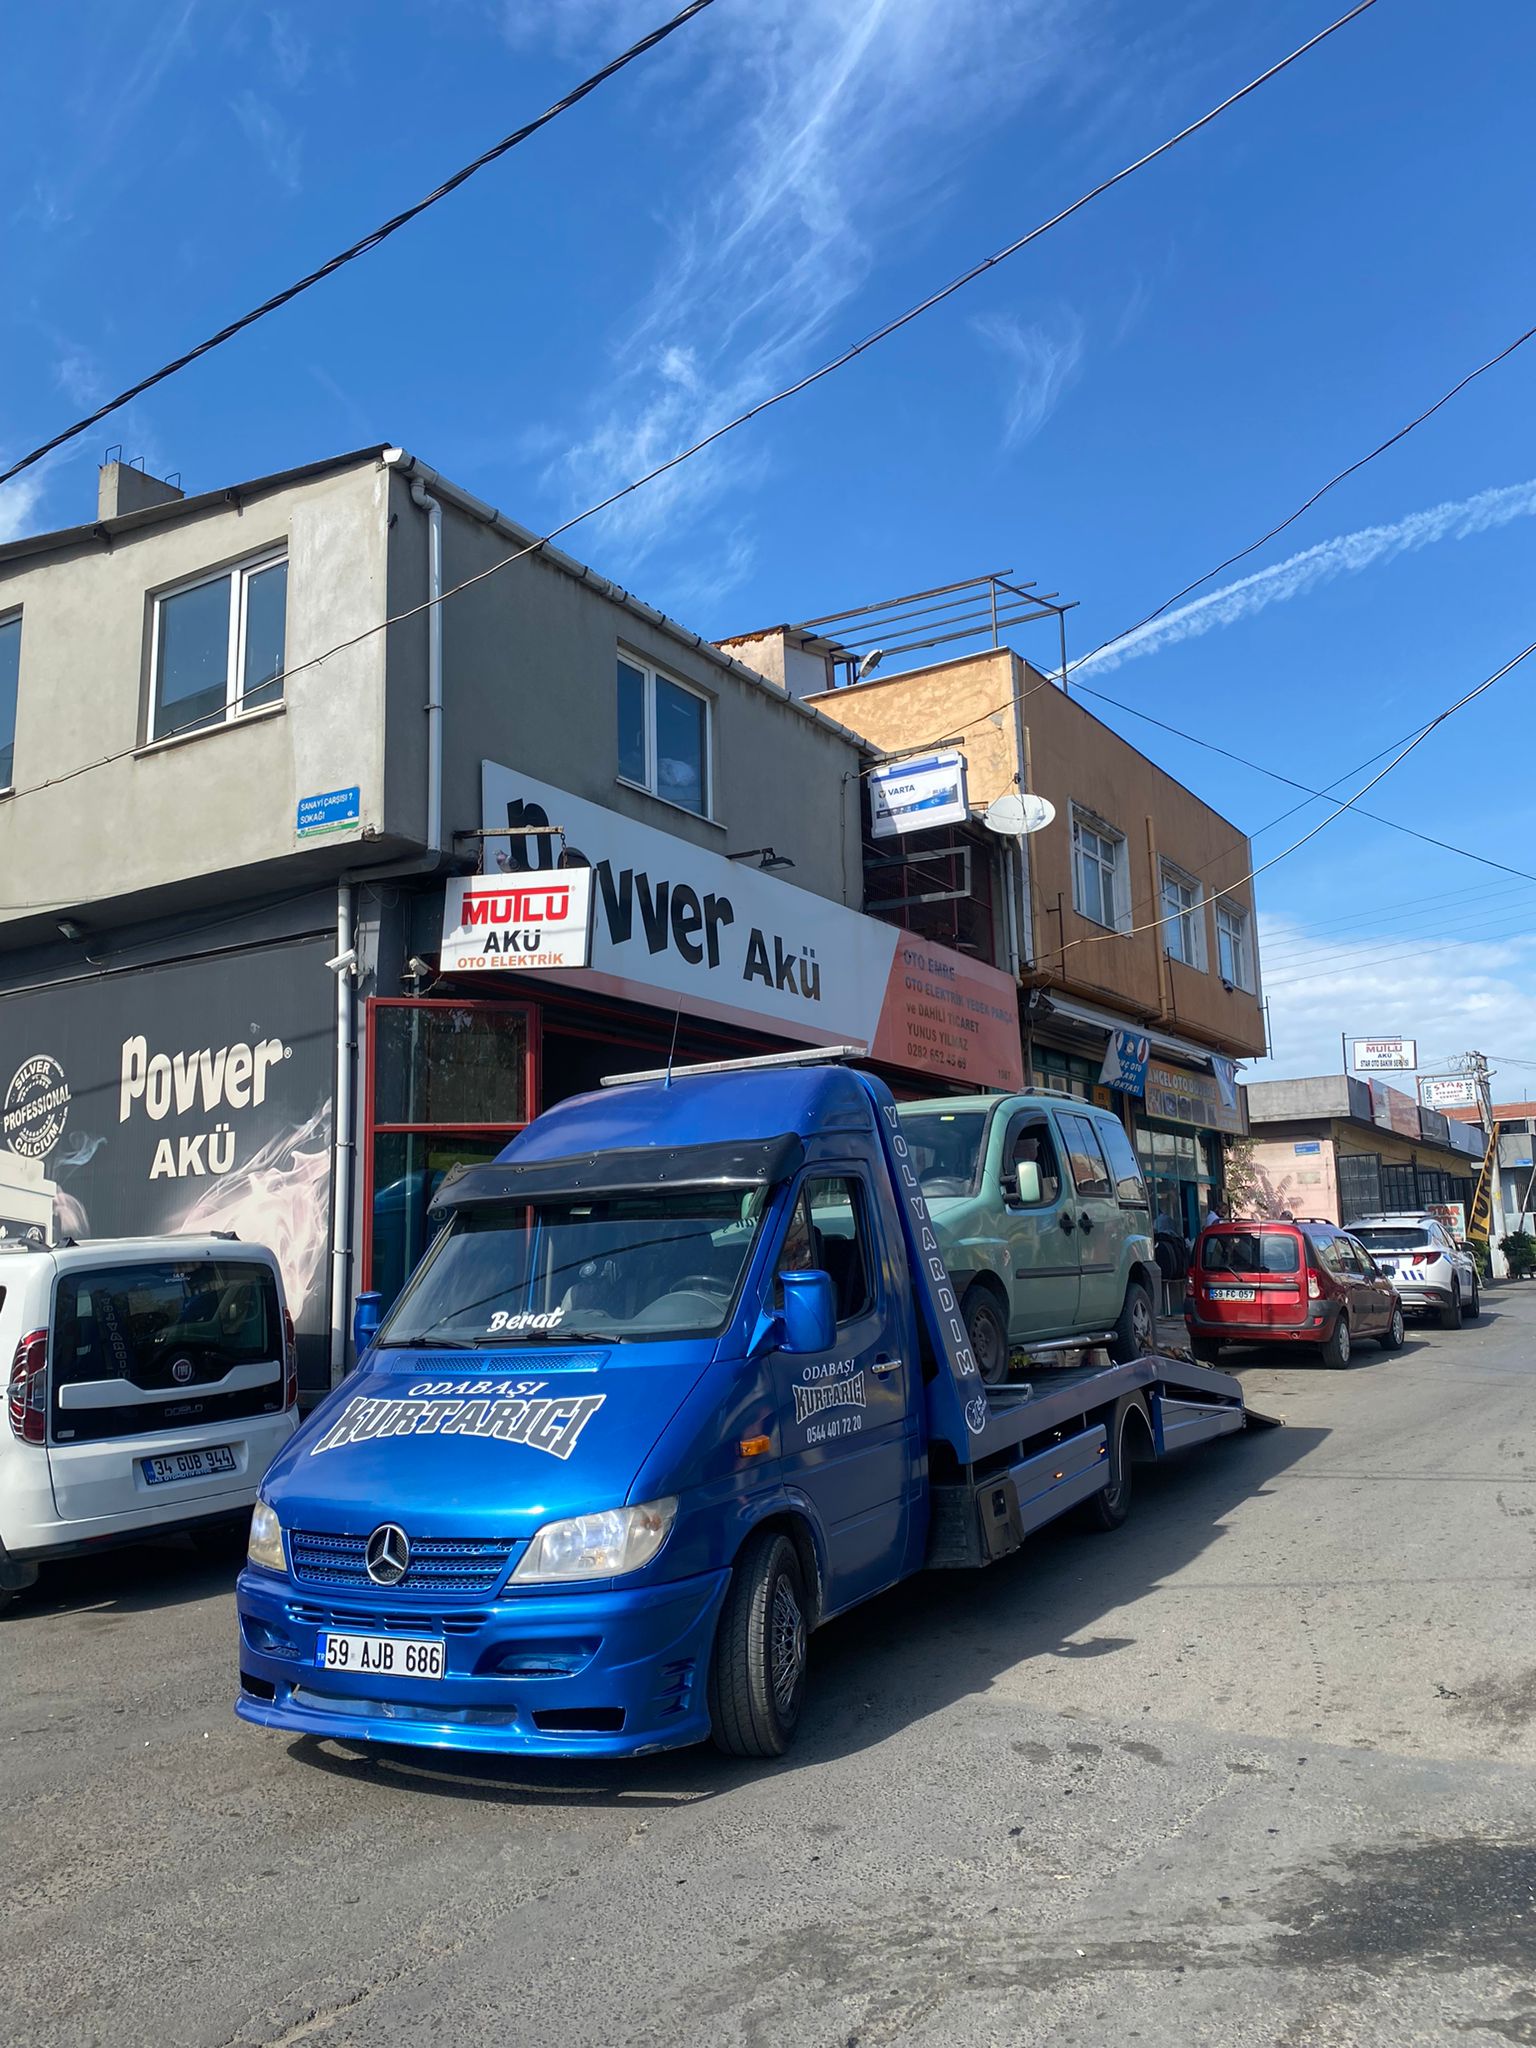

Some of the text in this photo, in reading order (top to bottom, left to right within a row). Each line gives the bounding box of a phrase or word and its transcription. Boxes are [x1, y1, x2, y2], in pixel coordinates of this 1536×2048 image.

[888, 784, 915, 796] VARTA
[300, 799, 323, 812] SANAYİ
[300, 811, 325, 824] SOKAĞI
[461, 885, 570, 926] MUTLU
[483, 929, 541, 954] AKÜ
[457, 951, 564, 969] OTO ELEKTRİK
[742, 927, 821, 1001] Akü
[903, 950, 956, 981] OTO EMRE
[905, 977, 923, 993] OTO
[906, 1002, 980, 1034] ve DAHİLİ TİCARET
[906, 1022, 969, 1052] YUNUS YILMAZ
[1366, 1043, 1402, 1053] MUTLU
[907, 1042, 928, 1060] 0282
[14, 1060, 51, 1090] SILVER
[1130, 1063, 1142, 1072] OTO
[1148, 1069, 1172, 1088] ANGEL
[1172, 1076, 1189, 1092] OTO
[1433, 1081, 1463, 1092] STAR
[3, 1084, 72, 1134] PROFESSIONAL
[15, 1122, 60, 1156] CALCIUM
[149, 1123, 236, 1179] AKÜ
[1427, 1205, 1459, 1215] STAR
[1226, 1290, 1236, 1298] FC
[1238, 1290, 1254, 1298] 057
[486, 1306, 566, 1333] Berat
[802, 1359, 855, 1381] ODABAŞI
[408, 1381, 550, 1398] ODABAŞI
[791, 1370, 867, 1425] KURTARICI
[310, 1393, 607, 1460] KURTARICI
[806, 1424, 826, 1443] 0544
[827, 1420, 840, 1437] 401
[154, 1459, 173, 1475] 34
[176, 1454, 202, 1472] GUB
[205, 1450, 230, 1467] 944
[327, 1638, 349, 1666] 59
[361, 1641, 394, 1670] AJB
[405, 1645, 440, 1674] 686
